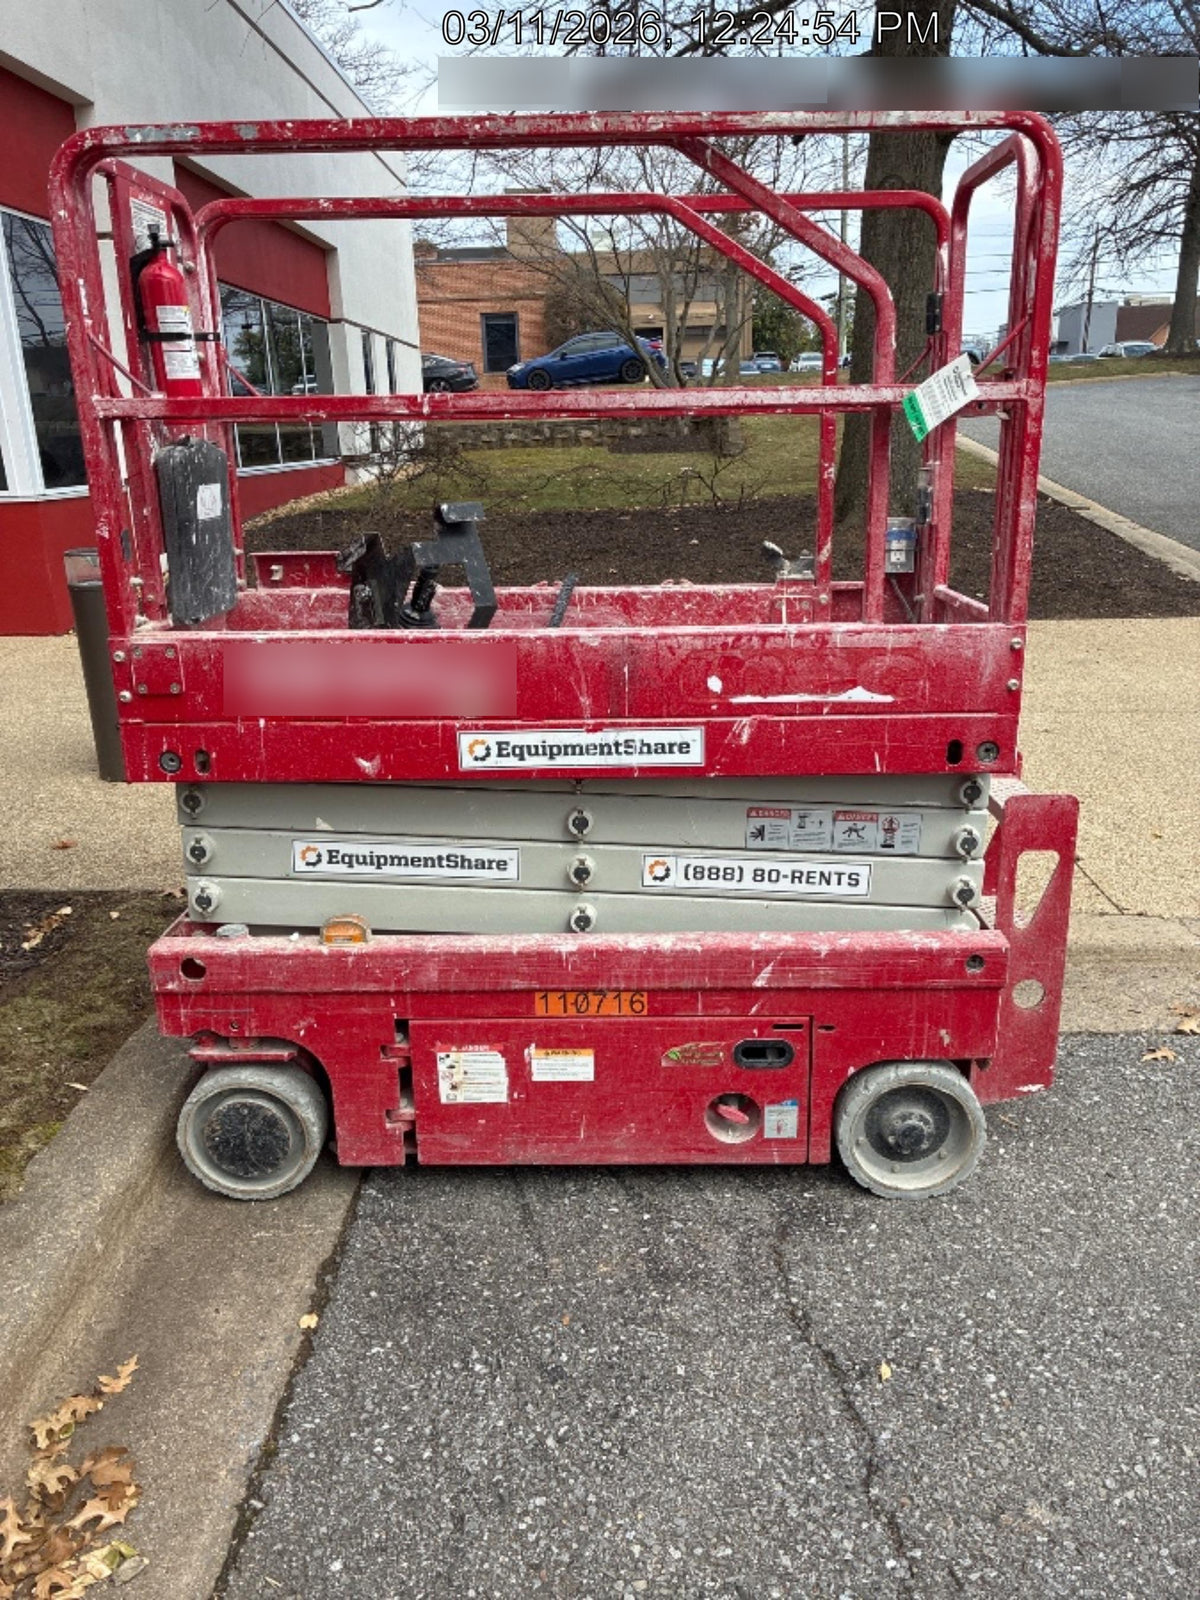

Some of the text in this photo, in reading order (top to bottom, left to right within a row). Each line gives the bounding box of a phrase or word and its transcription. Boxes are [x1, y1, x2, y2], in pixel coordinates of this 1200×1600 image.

[495, 738, 691, 761] EquipmentShare
[326, 849, 508, 871] EquipmentShare
[683, 863, 860, 887] (888) 80-RENTS
